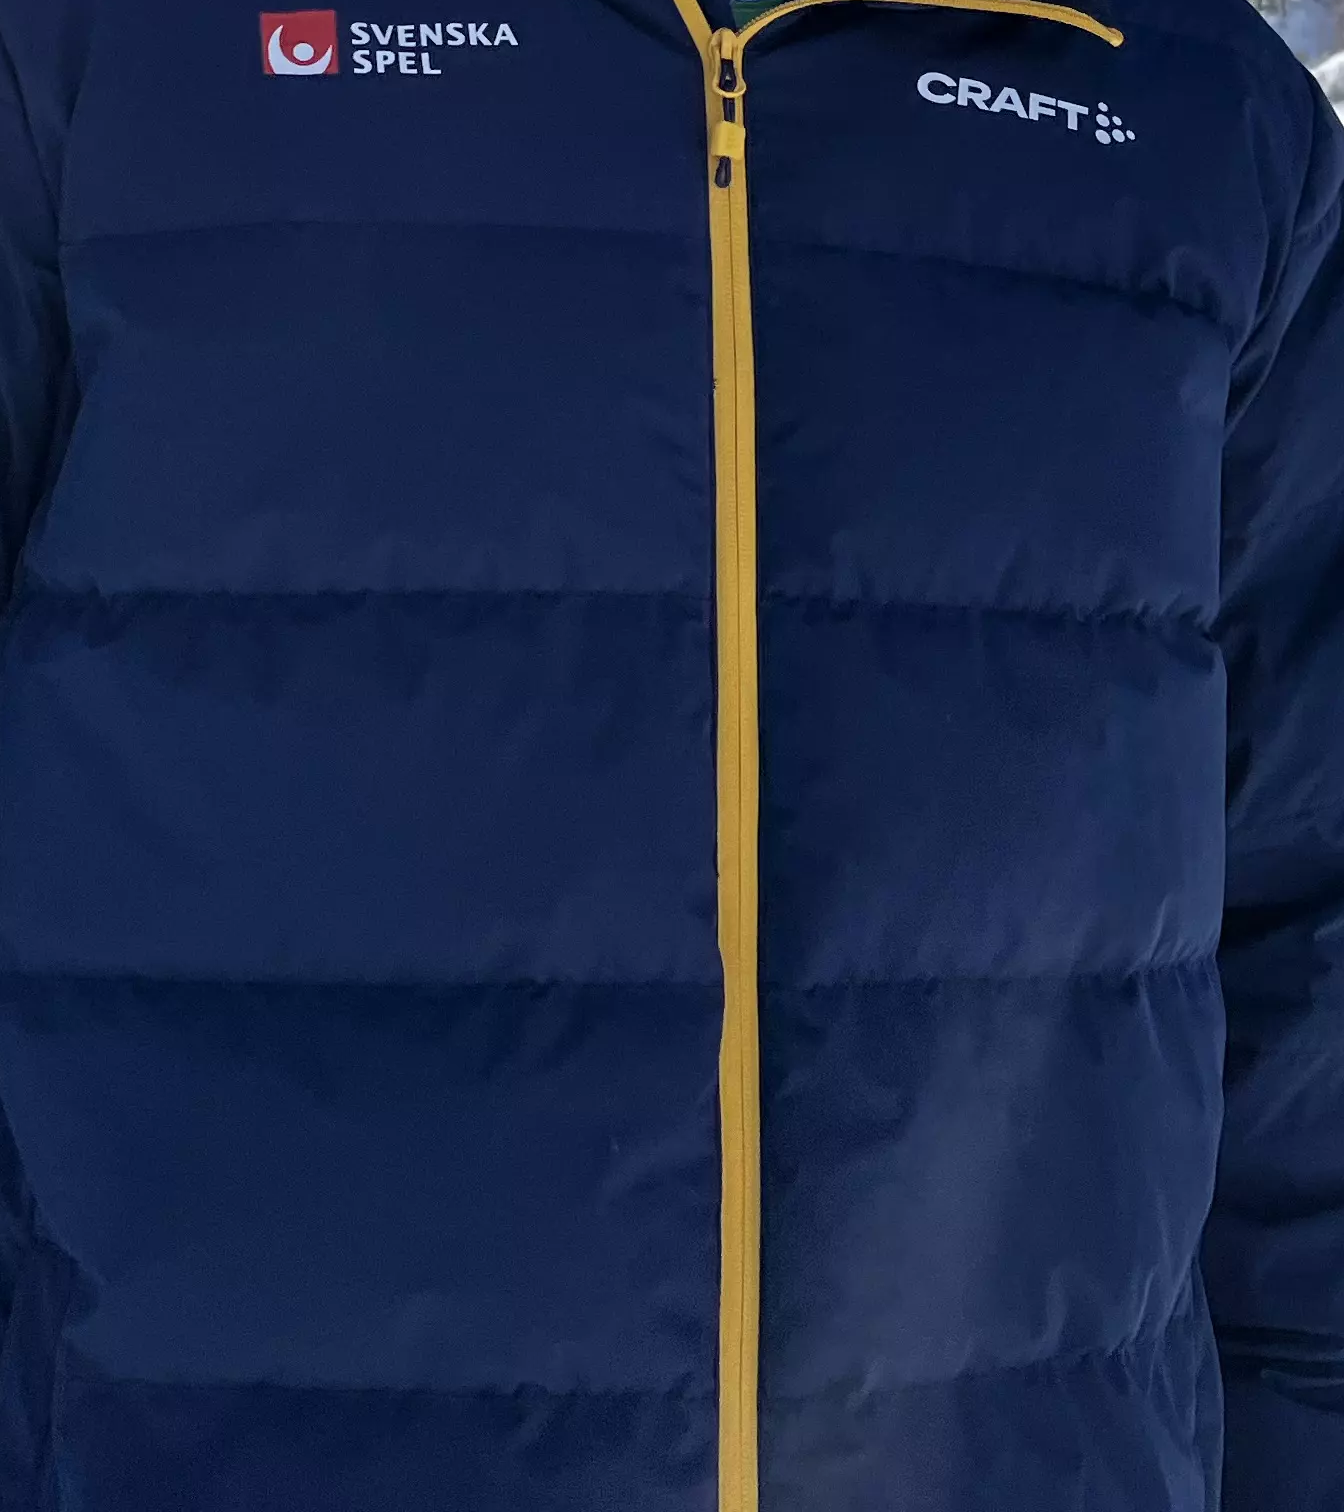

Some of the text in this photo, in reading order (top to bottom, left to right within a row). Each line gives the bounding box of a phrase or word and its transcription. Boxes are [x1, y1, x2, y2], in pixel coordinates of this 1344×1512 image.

[350, 21, 519, 47] SVENSKA
[352, 50, 442, 75] SPEL
[916, 71, 1089, 131] CRAFT
